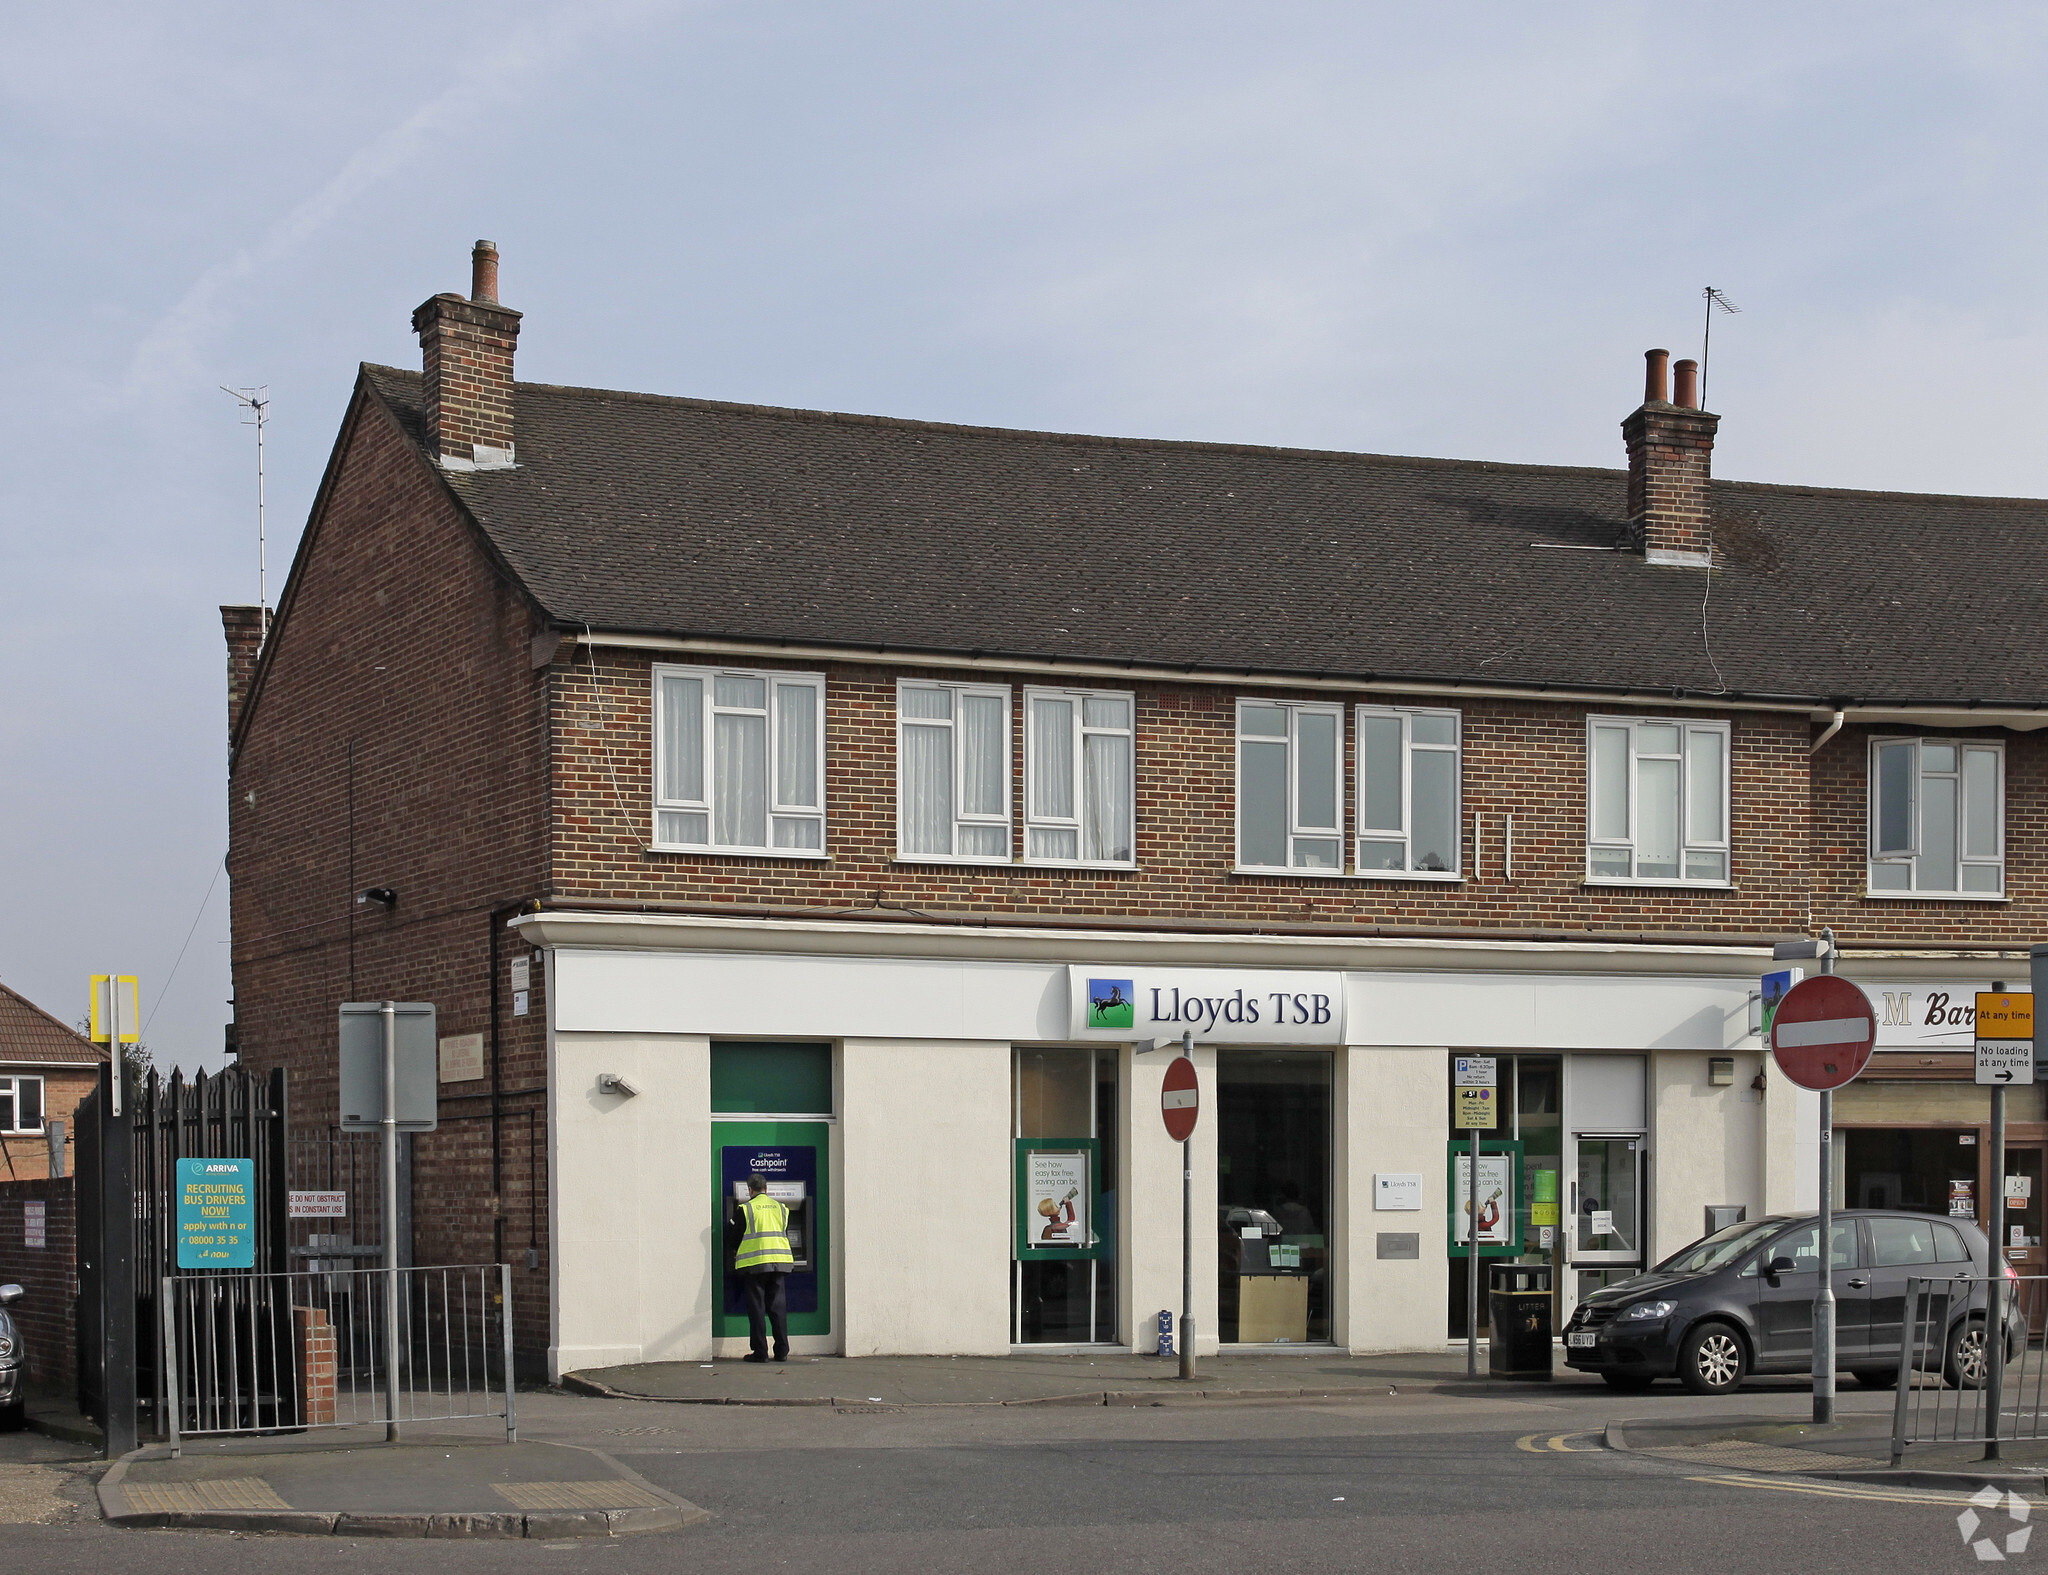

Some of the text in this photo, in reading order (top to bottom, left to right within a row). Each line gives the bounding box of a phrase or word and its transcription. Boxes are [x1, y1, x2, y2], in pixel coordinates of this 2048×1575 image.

[1150, 987, 1331, 1033] Lloyds TSB
[1882, 992, 1912, 1026] M
[1980, 1011, 2031, 1021] At any time
[1980, 1046, 2029, 1057] No loading
[1979, 1058, 2030, 1068] at any time
[1824, 1132, 1829, 1140] 5
[750, 1158, 787, 1168] Cashpoint
[1035, 1178, 1055, 1186] saving
[186, 1184, 244, 1194] RECRUITING
[184, 1195, 246, 1205] BUS DRIVERS
[201, 1206, 230, 1216] NOW!
[184, 1221, 207, 1232] apply
[189, 1236, 214, 1244] 08000
[216, 1236, 226, 1244] 35
[229, 1236, 239, 1244] 35
[1518, 1303, 1545, 1311] LITTER
